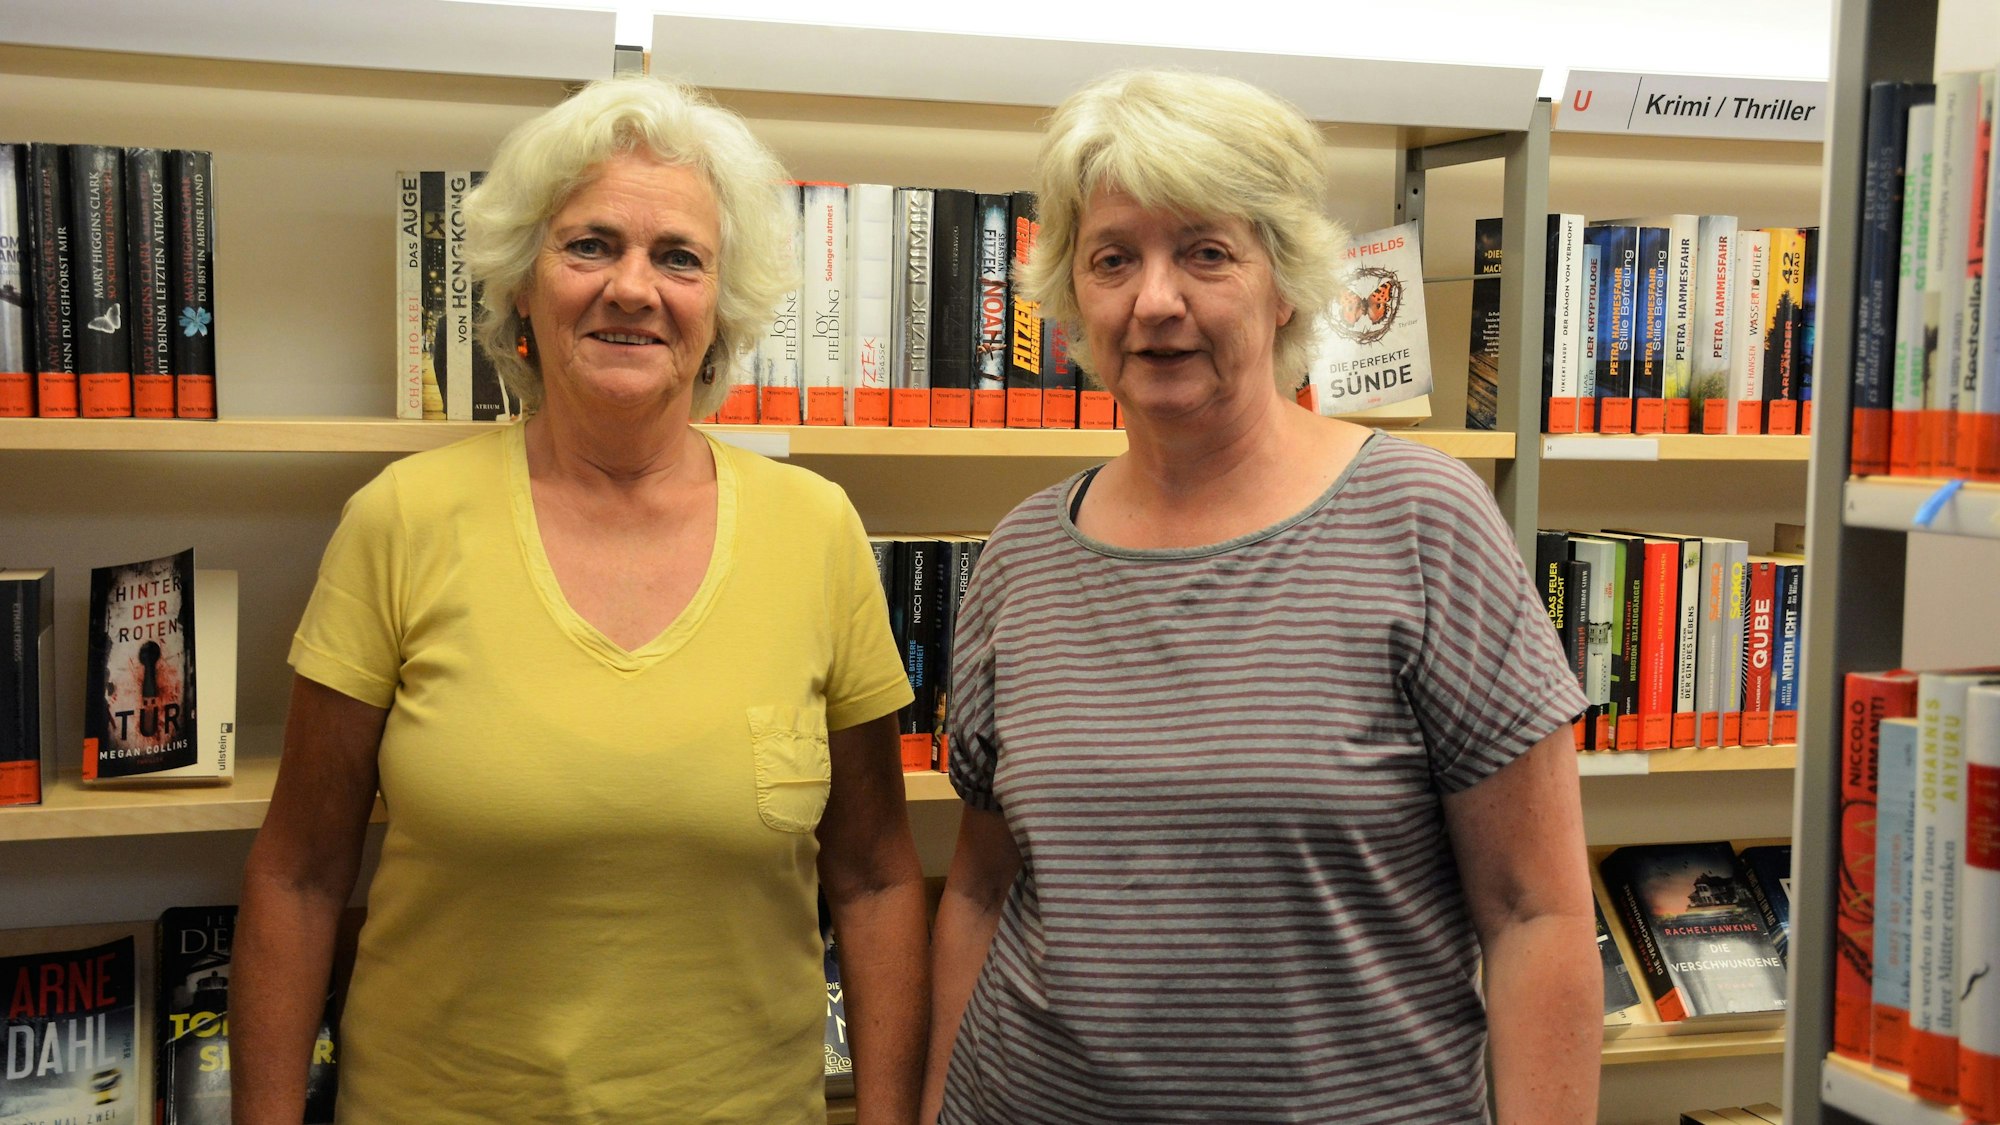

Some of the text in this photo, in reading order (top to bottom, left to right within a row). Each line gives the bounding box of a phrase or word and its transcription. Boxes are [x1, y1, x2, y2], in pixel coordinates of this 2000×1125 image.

[1573, 90, 1592, 112] U
[1645, 94, 1815, 121] Krimi / Thriller
[153, 183, 164, 244] ATEMZUG
[1864, 160, 1877, 220] ELIETTE
[58, 227, 68, 252] MIR
[89, 172, 104, 299] MARY HIGGINS CLARK
[194, 174, 206, 302] DU BIST IN MEINER HAND
[403, 178, 418, 268] DAS AUGE
[825, 236, 832, 247] du
[825, 248, 834, 282] Solange
[983, 229, 997, 275] FITZEK
[1360, 237, 1405, 257] FIELDS
[1782, 252, 1794, 284] 42
[59, 257, 70, 316] GEHÖRST
[155, 248, 166, 300] LETZTEN
[909, 196, 928, 371] FITZEK MIMIK
[1715, 236, 1727, 317] HAMMESFAHR
[983, 283, 1004, 345] NOAH
[1562, 285, 1570, 317] DÄMON
[1586, 259, 1598, 358] DER KRYPTOLOGE
[1609, 268, 1622, 375] PETRA HAMMESFAHR
[1619, 250, 1634, 351] Stille Befreiung
[1644, 268, 1656, 376] PETRA HAMMESFAHR
[1652, 250, 1667, 350] Stille Befreiung
[1676, 238, 1690, 361] PETRA HAMMESFAHR
[1857, 296, 1869, 328] wäre
[1870, 279, 1885, 336] gewesen
[62, 320, 71, 338] DU
[157, 305, 168, 353] DEINEM
[458, 315, 467, 343] VON
[770, 311, 786, 338] JOY
[812, 311, 828, 338] JOY
[828, 289, 839, 361] FIELDING
[1012, 294, 1032, 371] FITZEK
[1713, 320, 1724, 358] PETRA
[408, 297, 420, 408] CHAN HO-KEI
[876, 343, 885, 383] Insasse
[1329, 348, 1410, 374] DIE PERFEKTE
[1746, 346, 1756, 397] ULE HANSEN
[1854, 355, 1867, 386] Mit
[1330, 364, 1413, 399] SÜNDE
[115, 576, 183, 602] HINTER
[913, 551, 924, 624] NICCI FRENCH
[960, 553, 969, 592] FRENCH
[1549, 562, 1558, 593] FEUER
[1729, 562, 1742, 619] SOKO
[133, 600, 168, 620] DER
[1556, 576, 1565, 629] ENTFACHT
[119, 619, 178, 643] ROTEN
[1629, 580, 1640, 682] MISSION BLINDGÄNGER
[1753, 599, 1770, 668] QUBE
[1781, 610, 1797, 681] NORDLICHT
[909, 640, 917, 672] BITTERE
[916, 644, 924, 688] WAHRHEIT
[115, 699, 180, 741] TÜR
[99, 739, 188, 760] MEGAN COLLINS
[218, 735, 227, 771] ullstein
[1849, 701, 1865, 789] NICCOLÒ
[1922, 700, 1940, 815] JOHANNES
[1942, 716, 1959, 804] ANYURU
[1664, 923, 1758, 936] RACHEL HAWKINS
[1919, 827, 1935, 1008] werden in den Tränen
[1938, 842, 1956, 1030] ihrer Mütter ertrinken
[1653, 959, 1664, 976] DIE
[1671, 957, 1780, 972] VERSCHWUNDENE
[1709, 944, 1731, 954] DIE
[8, 952, 117, 1020] ARNE
[826, 982, 840, 990] DIE
[6, 1013, 116, 1080] DAHL
[87, 1110, 116, 1125] ZWEI
